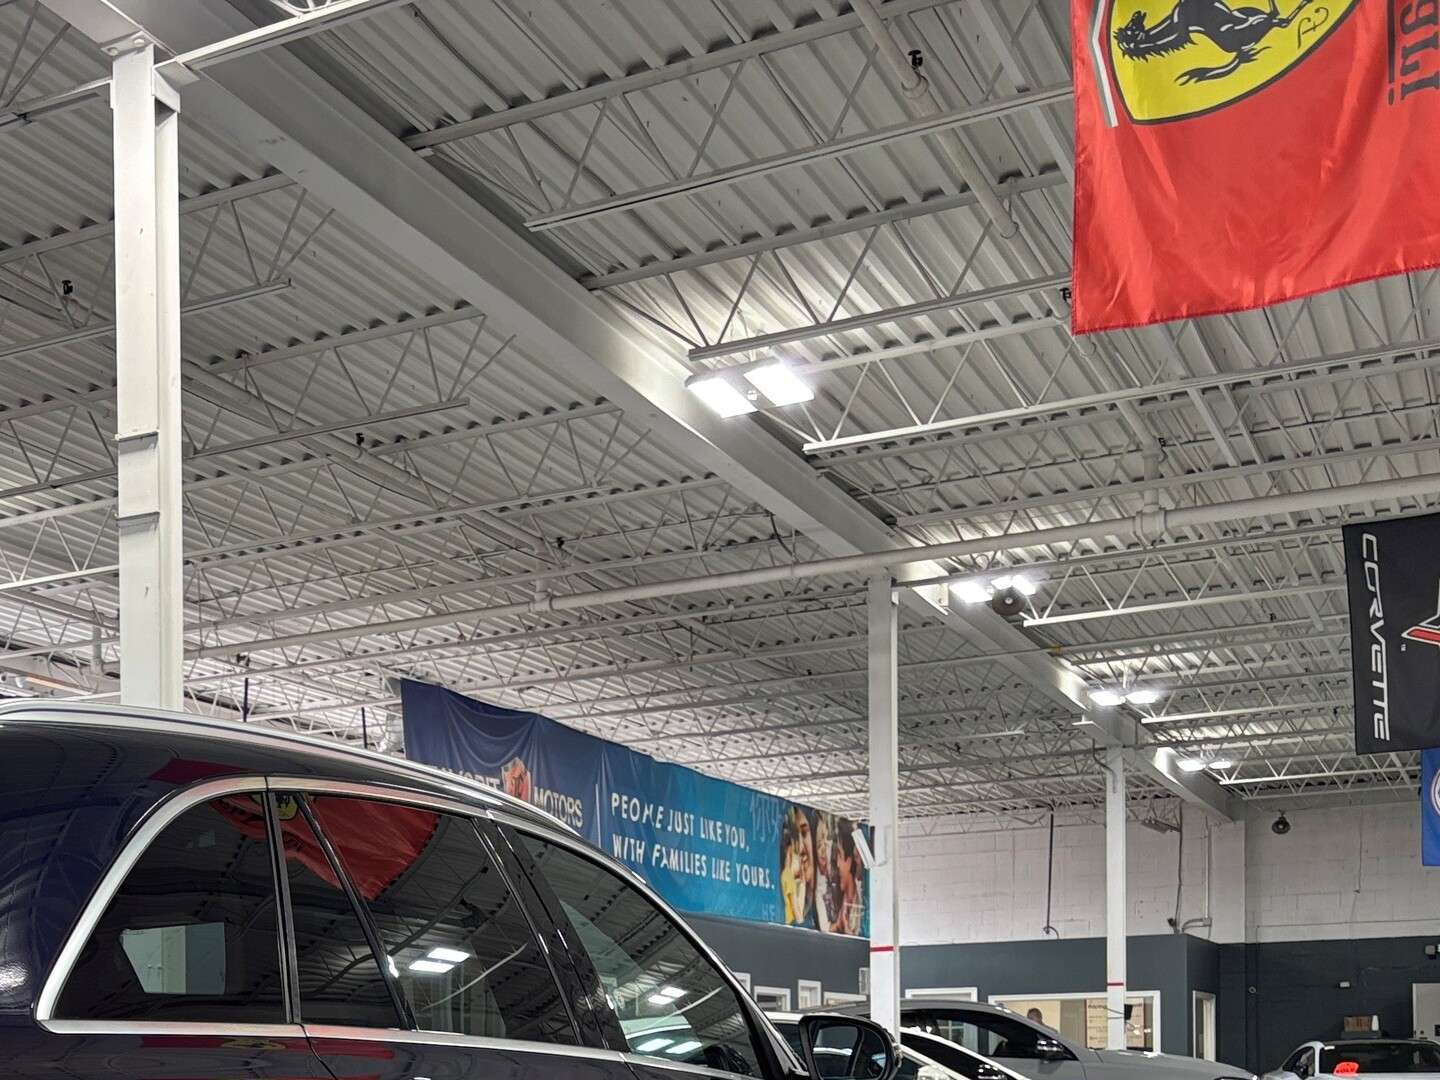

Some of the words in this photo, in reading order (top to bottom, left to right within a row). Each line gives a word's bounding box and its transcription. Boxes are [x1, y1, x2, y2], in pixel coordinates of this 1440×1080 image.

[1362, 532, 1391, 741] CORVETTE
[533, 785, 583, 828] MOTORS
[667, 808, 695, 836] JUST
[699, 816, 723, 843] LIKE
[725, 823, 750, 853] YOU,
[612, 833, 645, 865] WITH
[652, 844, 708, 878] FAMILIES
[711, 857, 732, 883] LIKE
[735, 862, 776, 890] YOURS.
